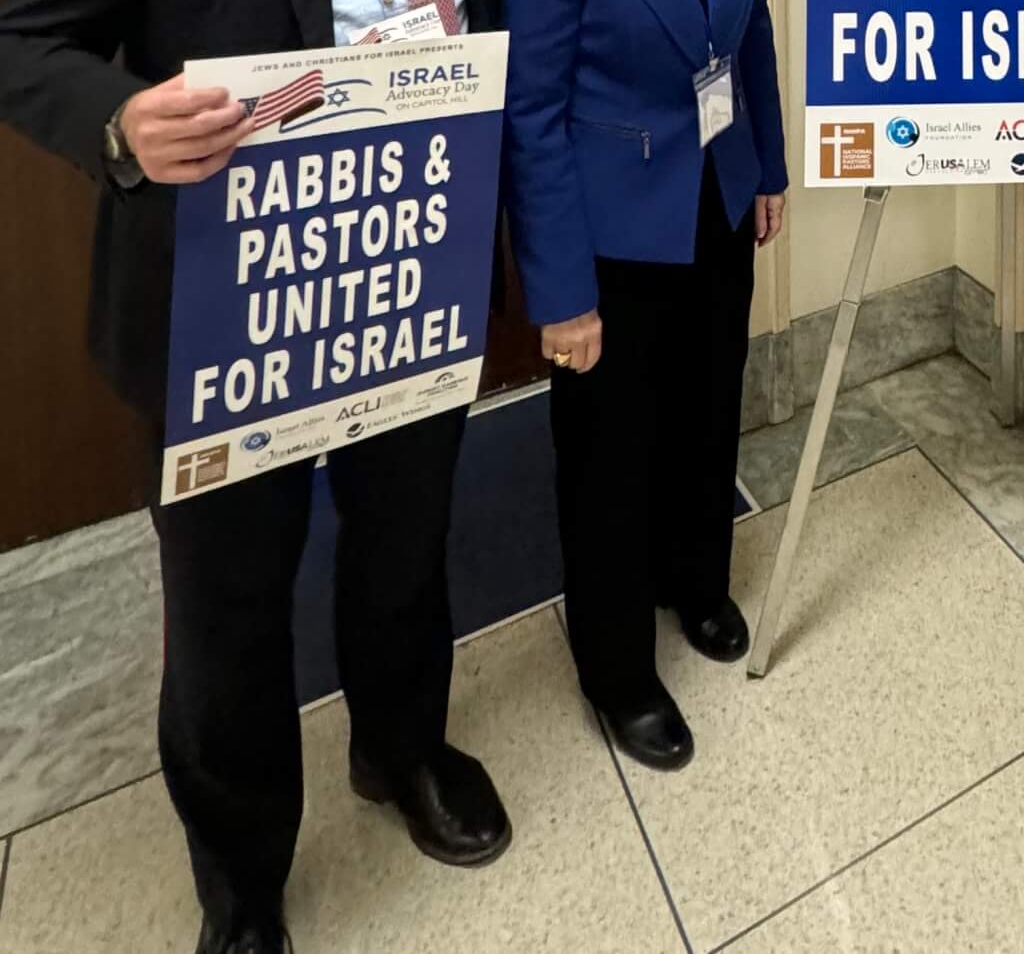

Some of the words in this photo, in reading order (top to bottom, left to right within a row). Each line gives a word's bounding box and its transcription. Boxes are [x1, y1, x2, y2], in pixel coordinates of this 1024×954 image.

[402, 11, 438, 28] ISRAEL
[832, 11, 937, 82] FOR
[389, 62, 479, 88] ISRAEL
[386, 85, 452, 102] Advocacy
[454, 82, 480, 94] Day
[412, 98, 448, 109] CAPITOL
[926, 122, 952, 132] Israel
[954, 122, 982, 132] Allies
[226, 141, 404, 222] RABBIS
[424, 134, 452, 186] &
[236, 194, 448, 285] PASTORS
[248, 258, 422, 345] UNITED
[192, 349, 290, 424] FOR
[312, 304, 468, 390] ISRAEL
[336, 396, 382, 422] ACLI
